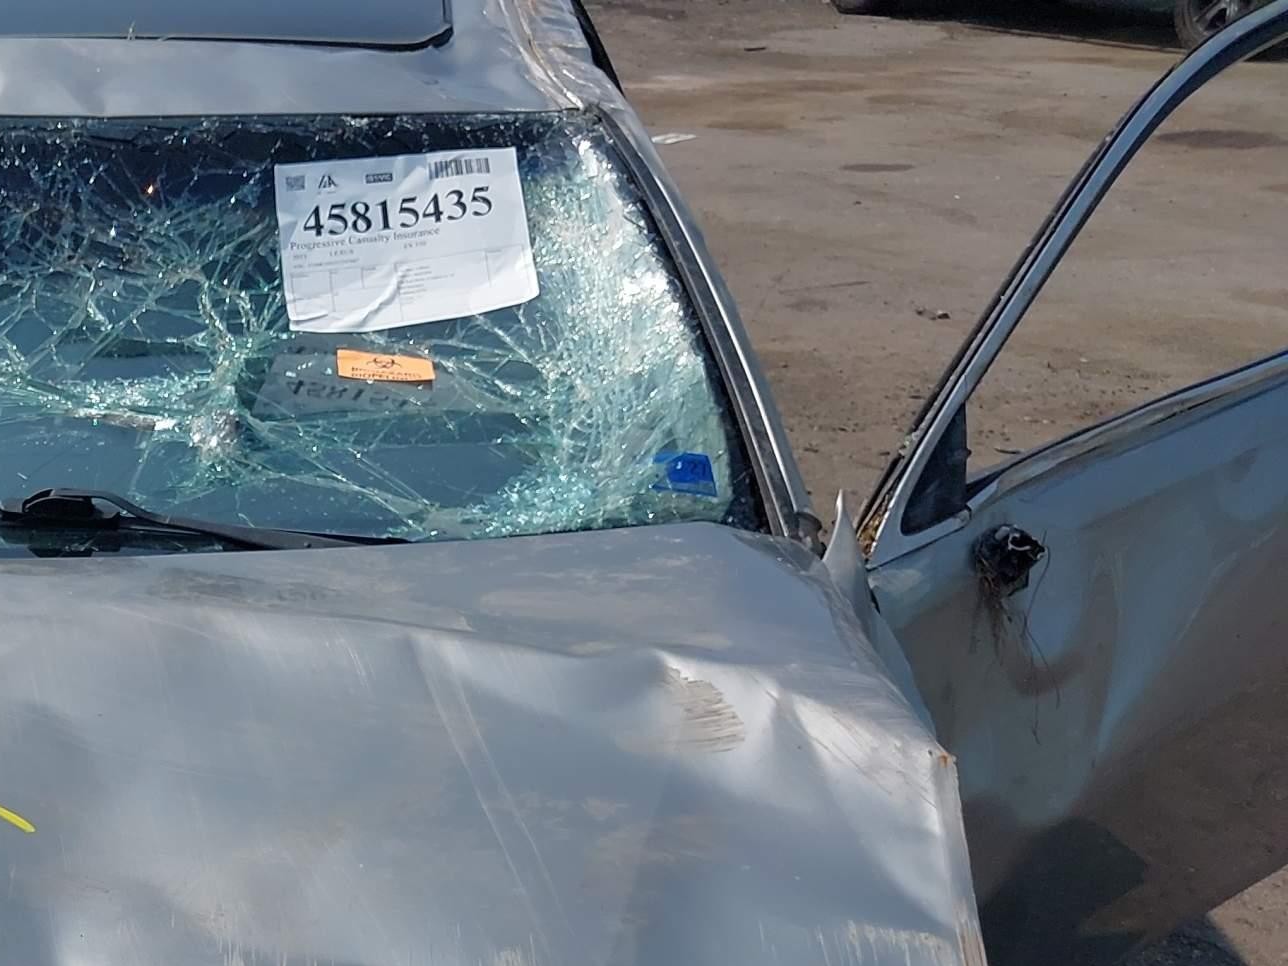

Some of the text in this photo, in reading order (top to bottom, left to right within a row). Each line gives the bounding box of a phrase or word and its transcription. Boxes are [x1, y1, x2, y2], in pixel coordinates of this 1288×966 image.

[303, 186, 492, 237] 45815435
[290, 239, 346, 250] Progressive
[348, 233, 390, 246] Casualty
[393, 228, 440, 240] Insurance
